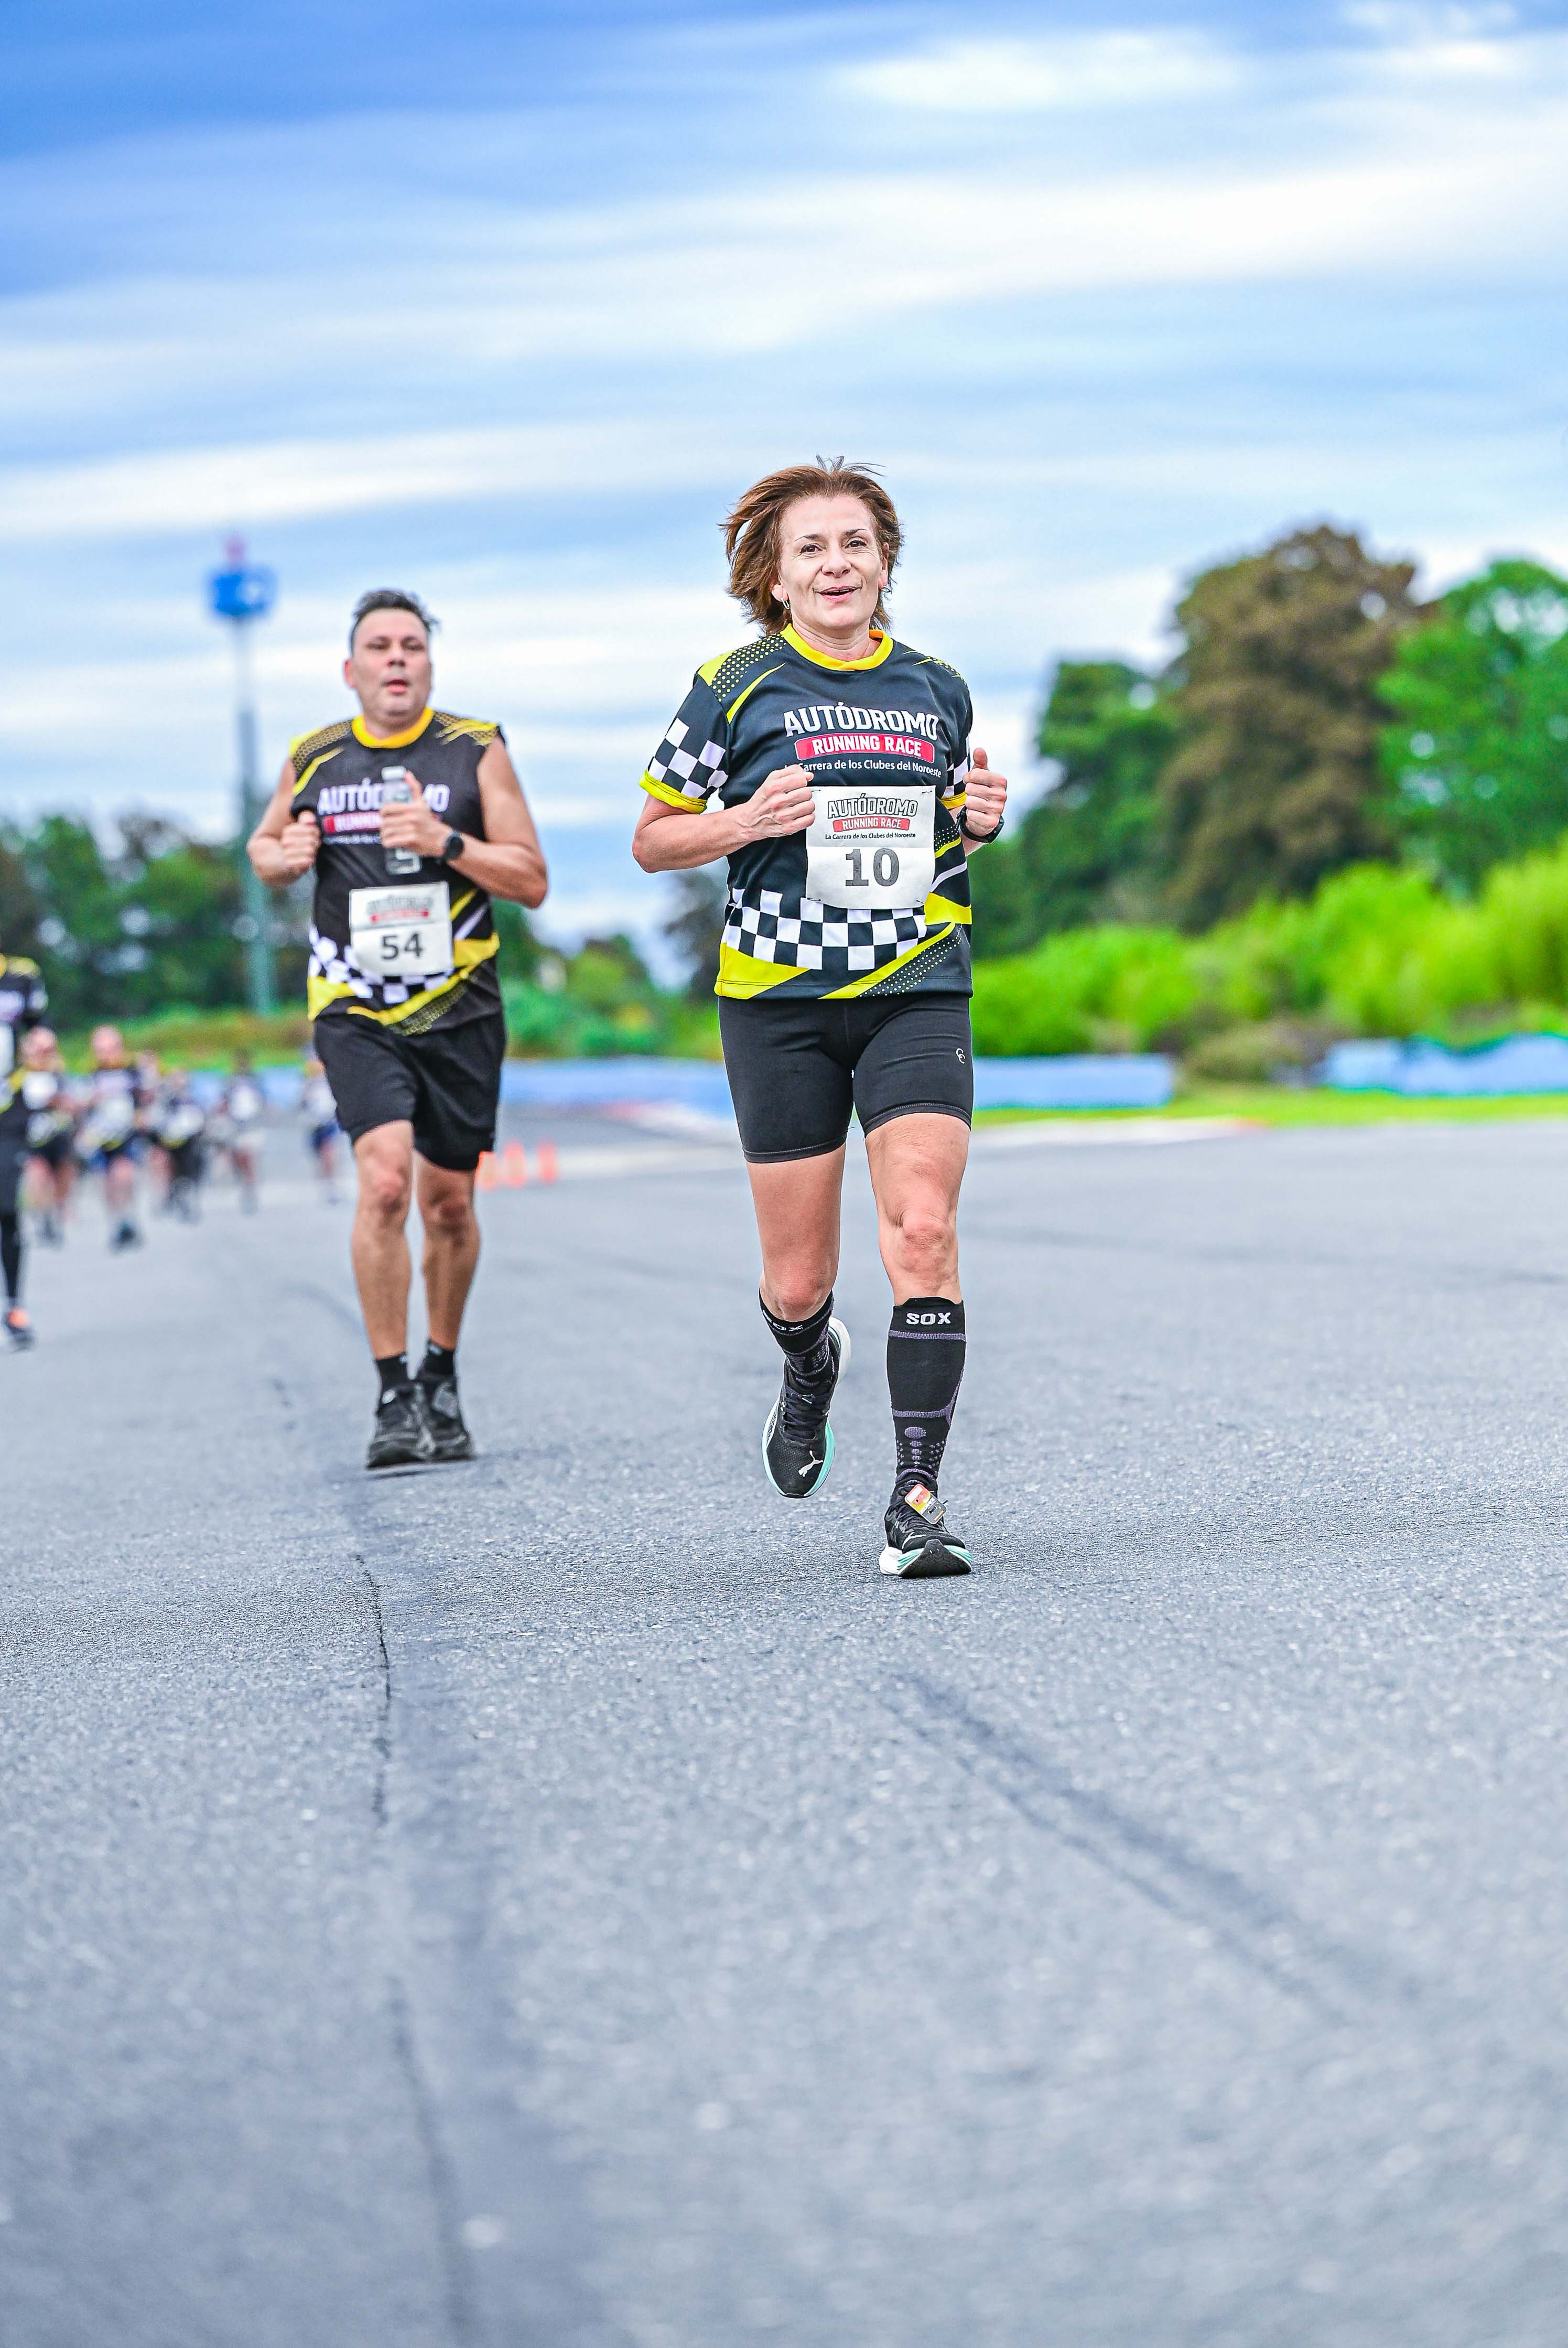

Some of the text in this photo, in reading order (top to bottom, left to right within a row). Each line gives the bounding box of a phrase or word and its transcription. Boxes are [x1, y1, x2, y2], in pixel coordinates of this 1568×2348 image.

[783, 702, 939, 741] AUTÓDROMO
[812, 735, 922, 757] RUNNING RACE
[834, 759, 847, 769] de
[848, 759, 862, 769] los
[863, 760, 895, 770] Clubes
[896, 761, 911, 771] del
[912, 762, 942, 778] Noroeste
[827, 793, 918, 818] AUTÓDROMO
[842, 817, 902, 830] RUNNING RACE
[845, 848, 900, 887] 10
[381, 934, 424, 960] 54
[906, 1312, 951, 1325] SOX
